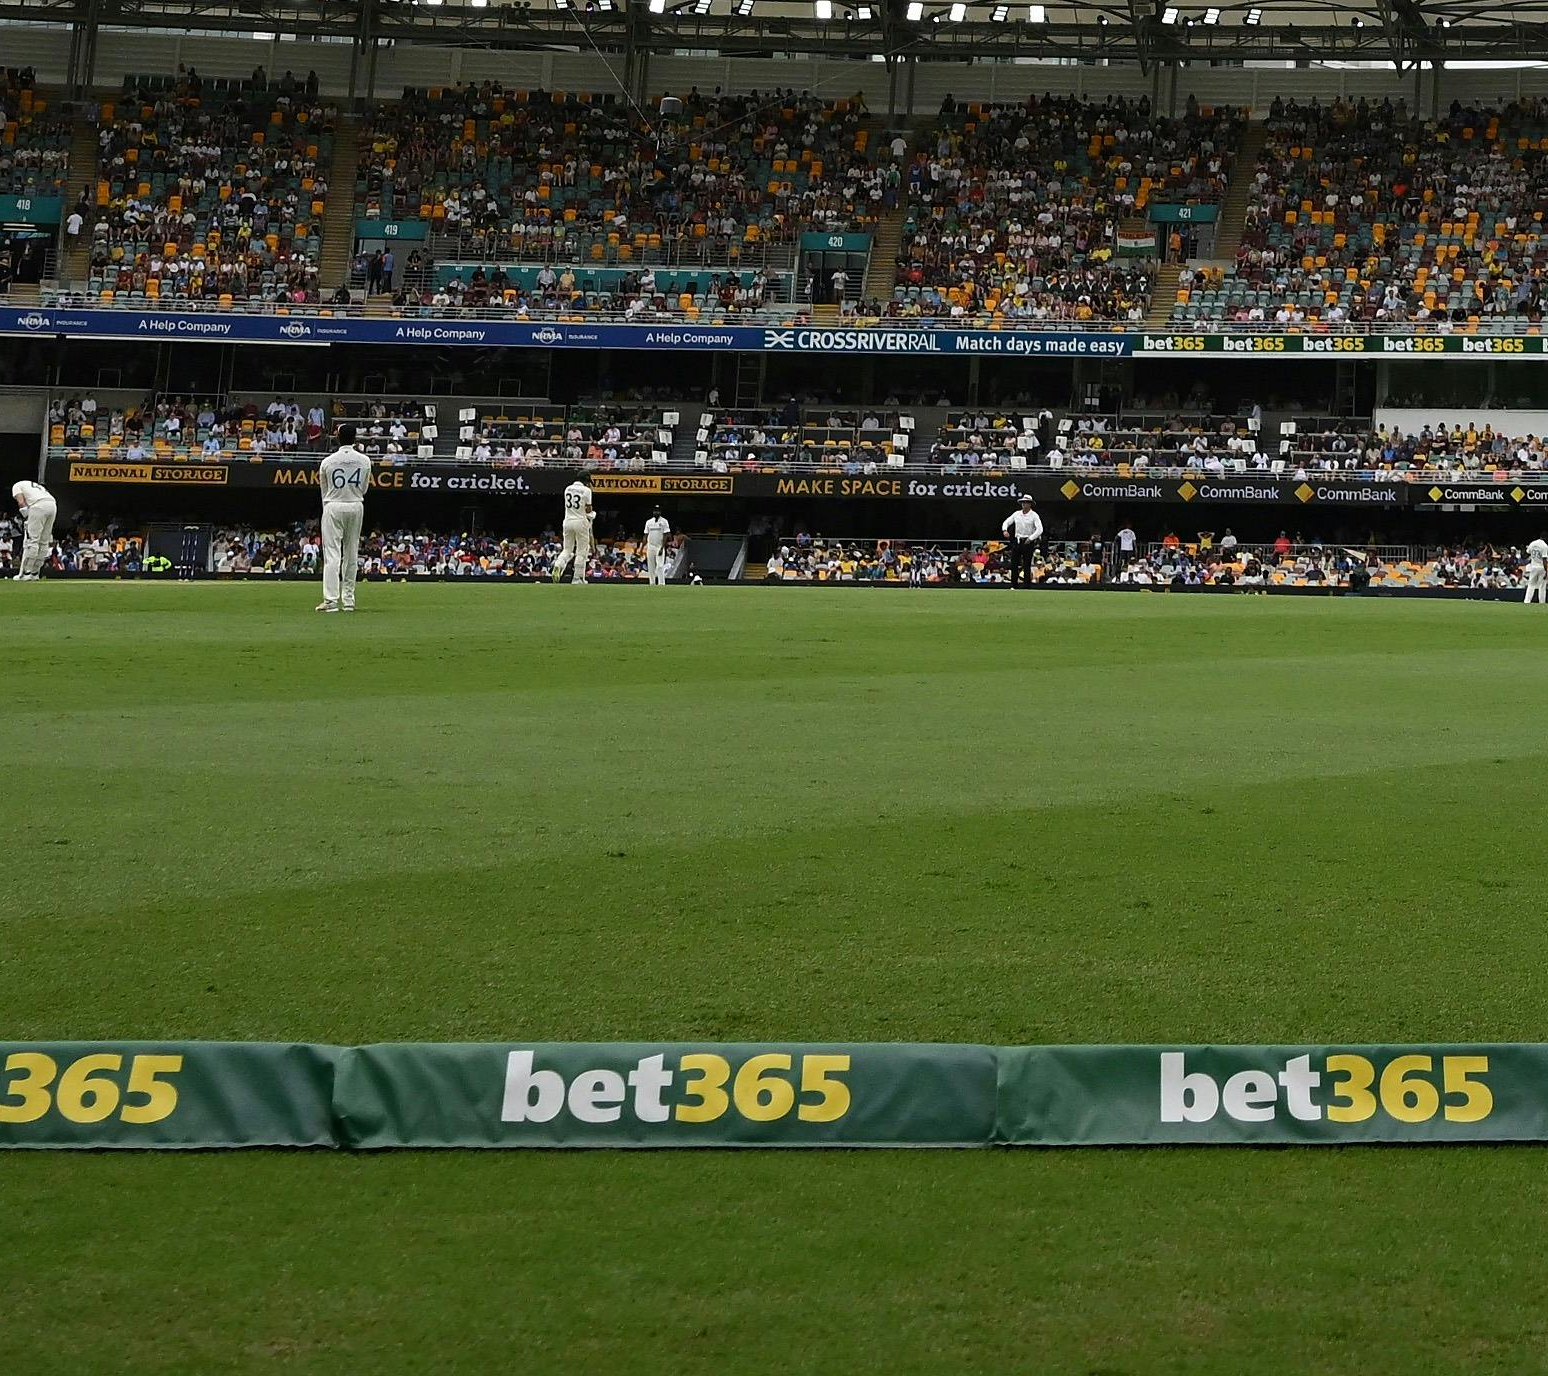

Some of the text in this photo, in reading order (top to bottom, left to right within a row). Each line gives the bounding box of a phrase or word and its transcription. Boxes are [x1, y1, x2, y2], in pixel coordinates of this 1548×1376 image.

[16, 199, 30, 210] 418
[1179, 208, 1192, 218] 421
[384, 224, 398, 236] 419
[827, 235, 843, 247] 420
[18, 316, 50, 328] NRMA
[139, 319, 231, 334] A Help Company
[280, 325, 311, 336] NRMA
[532, 331, 562, 341] NRMA
[646, 333, 733, 346] A Help Company
[798, 329, 940, 351] CROSSRIVERRAIL
[956, 335, 1124, 355] Match days made easy
[1143, 335, 1204, 351] bet365
[1384, 337, 1444, 352] bet365
[74, 467, 223, 481] NATIONAL STORAGE
[332, 467, 362, 489] 64
[1083, 483, 1162, 498] CommBank
[1444, 487, 1504, 501] CommBank
[566, 493, 581, 509] 33
[499, 1051, 852, 1124] bet365
[1160, 1052, 1493, 1122] bet365
